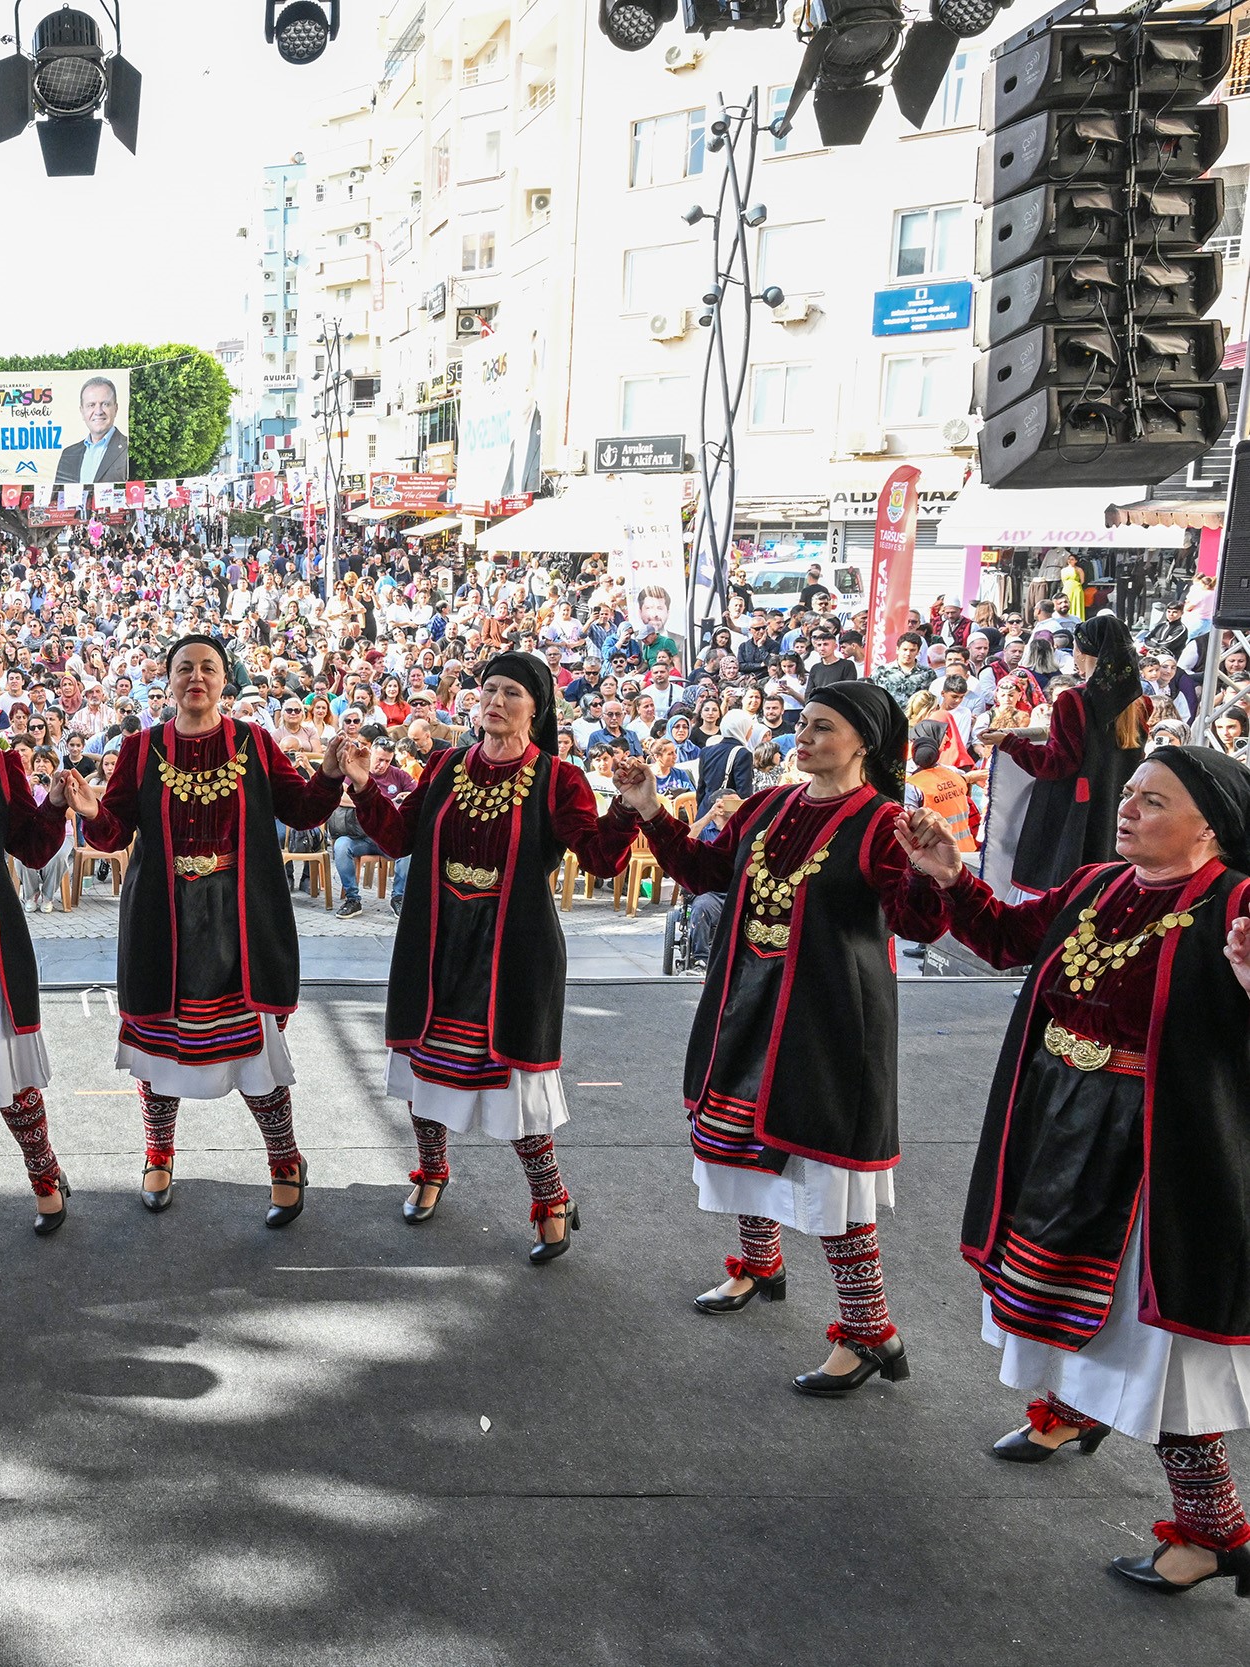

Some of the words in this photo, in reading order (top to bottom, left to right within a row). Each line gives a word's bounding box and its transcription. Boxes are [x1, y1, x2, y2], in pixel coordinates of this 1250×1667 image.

[263, 374, 296, 382] AVUKAT
[10, 405, 53, 418] Festivali
[621, 443, 654, 455] Avukat
[620, 456, 632, 467] M.
[879, 529, 907, 544] TARSUS
[997, 530, 1033, 544] MY
[1040, 530, 1114, 542] MODA
[936, 779, 956, 792] ÖZEL
